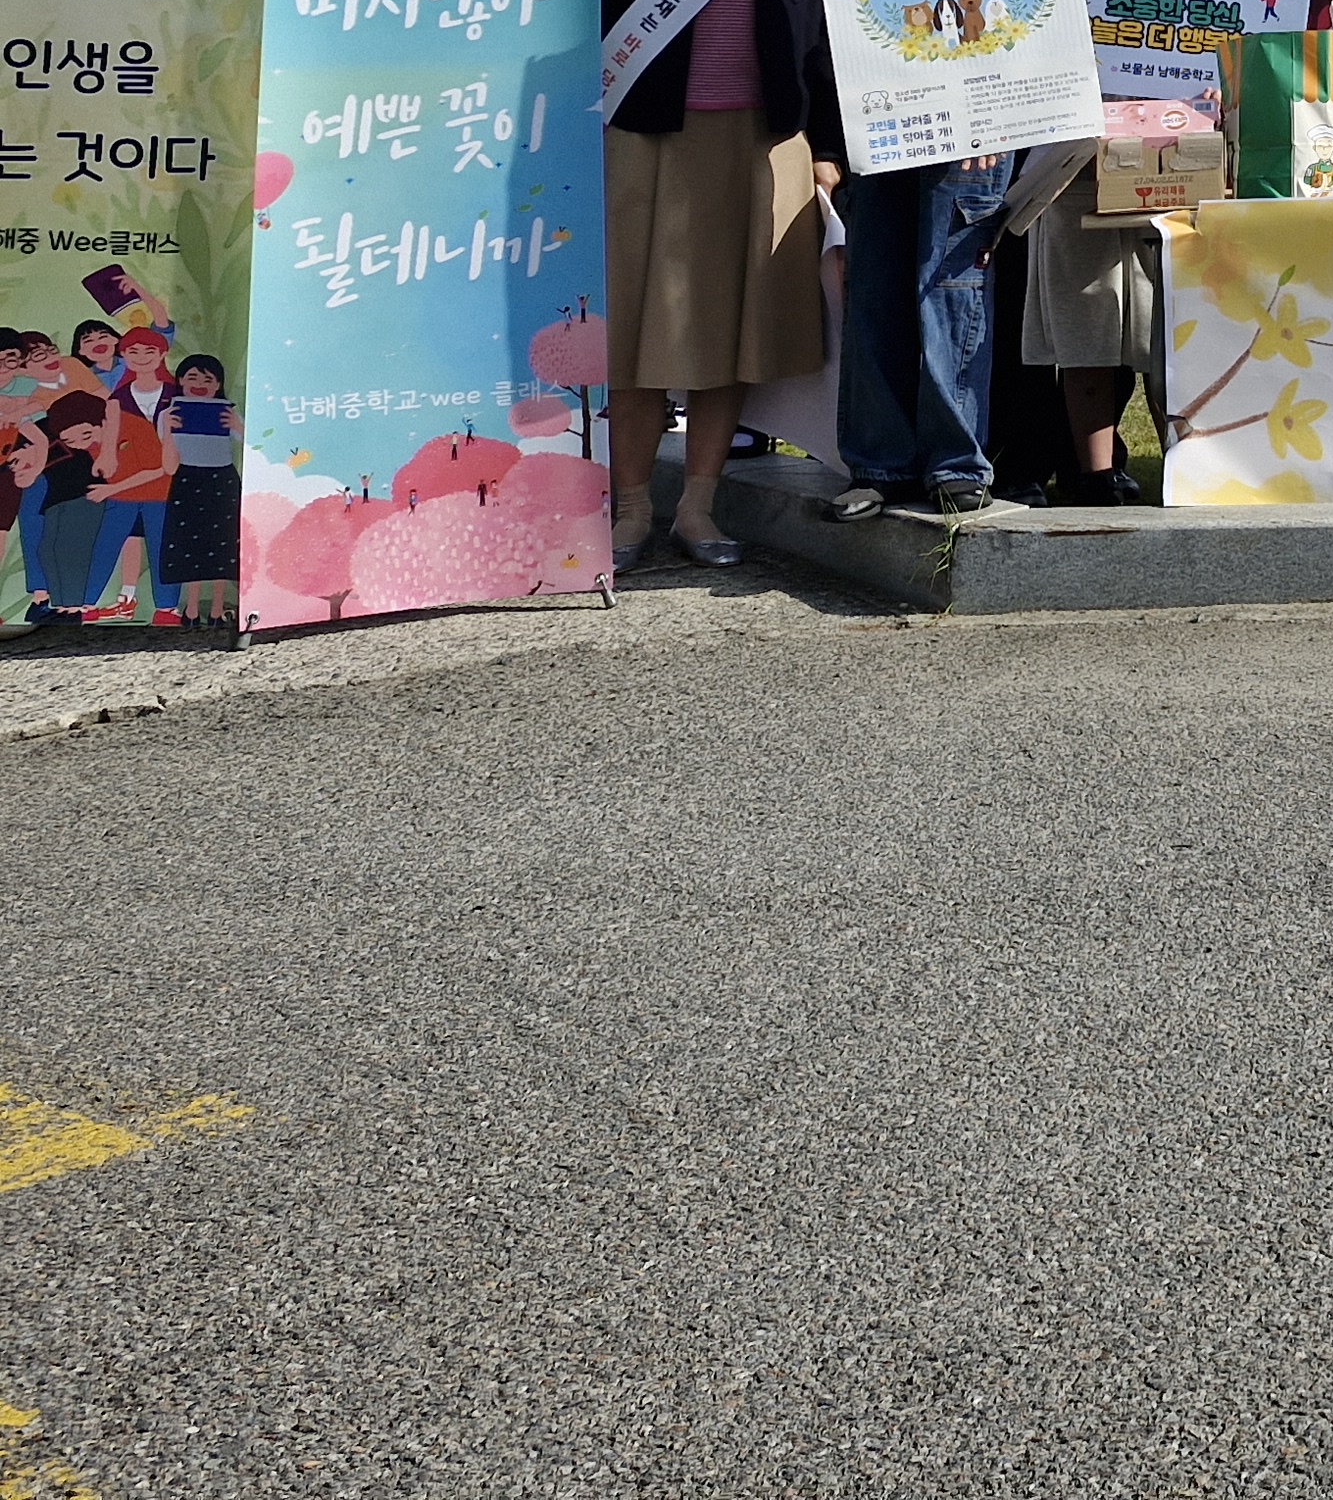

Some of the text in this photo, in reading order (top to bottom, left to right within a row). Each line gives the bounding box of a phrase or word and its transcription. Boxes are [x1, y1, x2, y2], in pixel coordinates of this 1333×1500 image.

[611, 32, 644, 69] 바로
[1089, 17, 1254, 54] 늘은 더 행복
[2, 37, 160, 95] 인생을
[1119, 61, 1216, 84] 보물섬 남해중학교
[301, 80, 548, 174] 예쁜 꽃이
[935, 111, 952, 123] 개!
[938, 126, 954, 139] 개!
[56, 131, 216, 182] 것이다
[940, 141, 957, 153] 개!
[48, 229, 181, 256] Wee클래스
[284, 379, 569, 425] 남해중학교 wee 클래스
